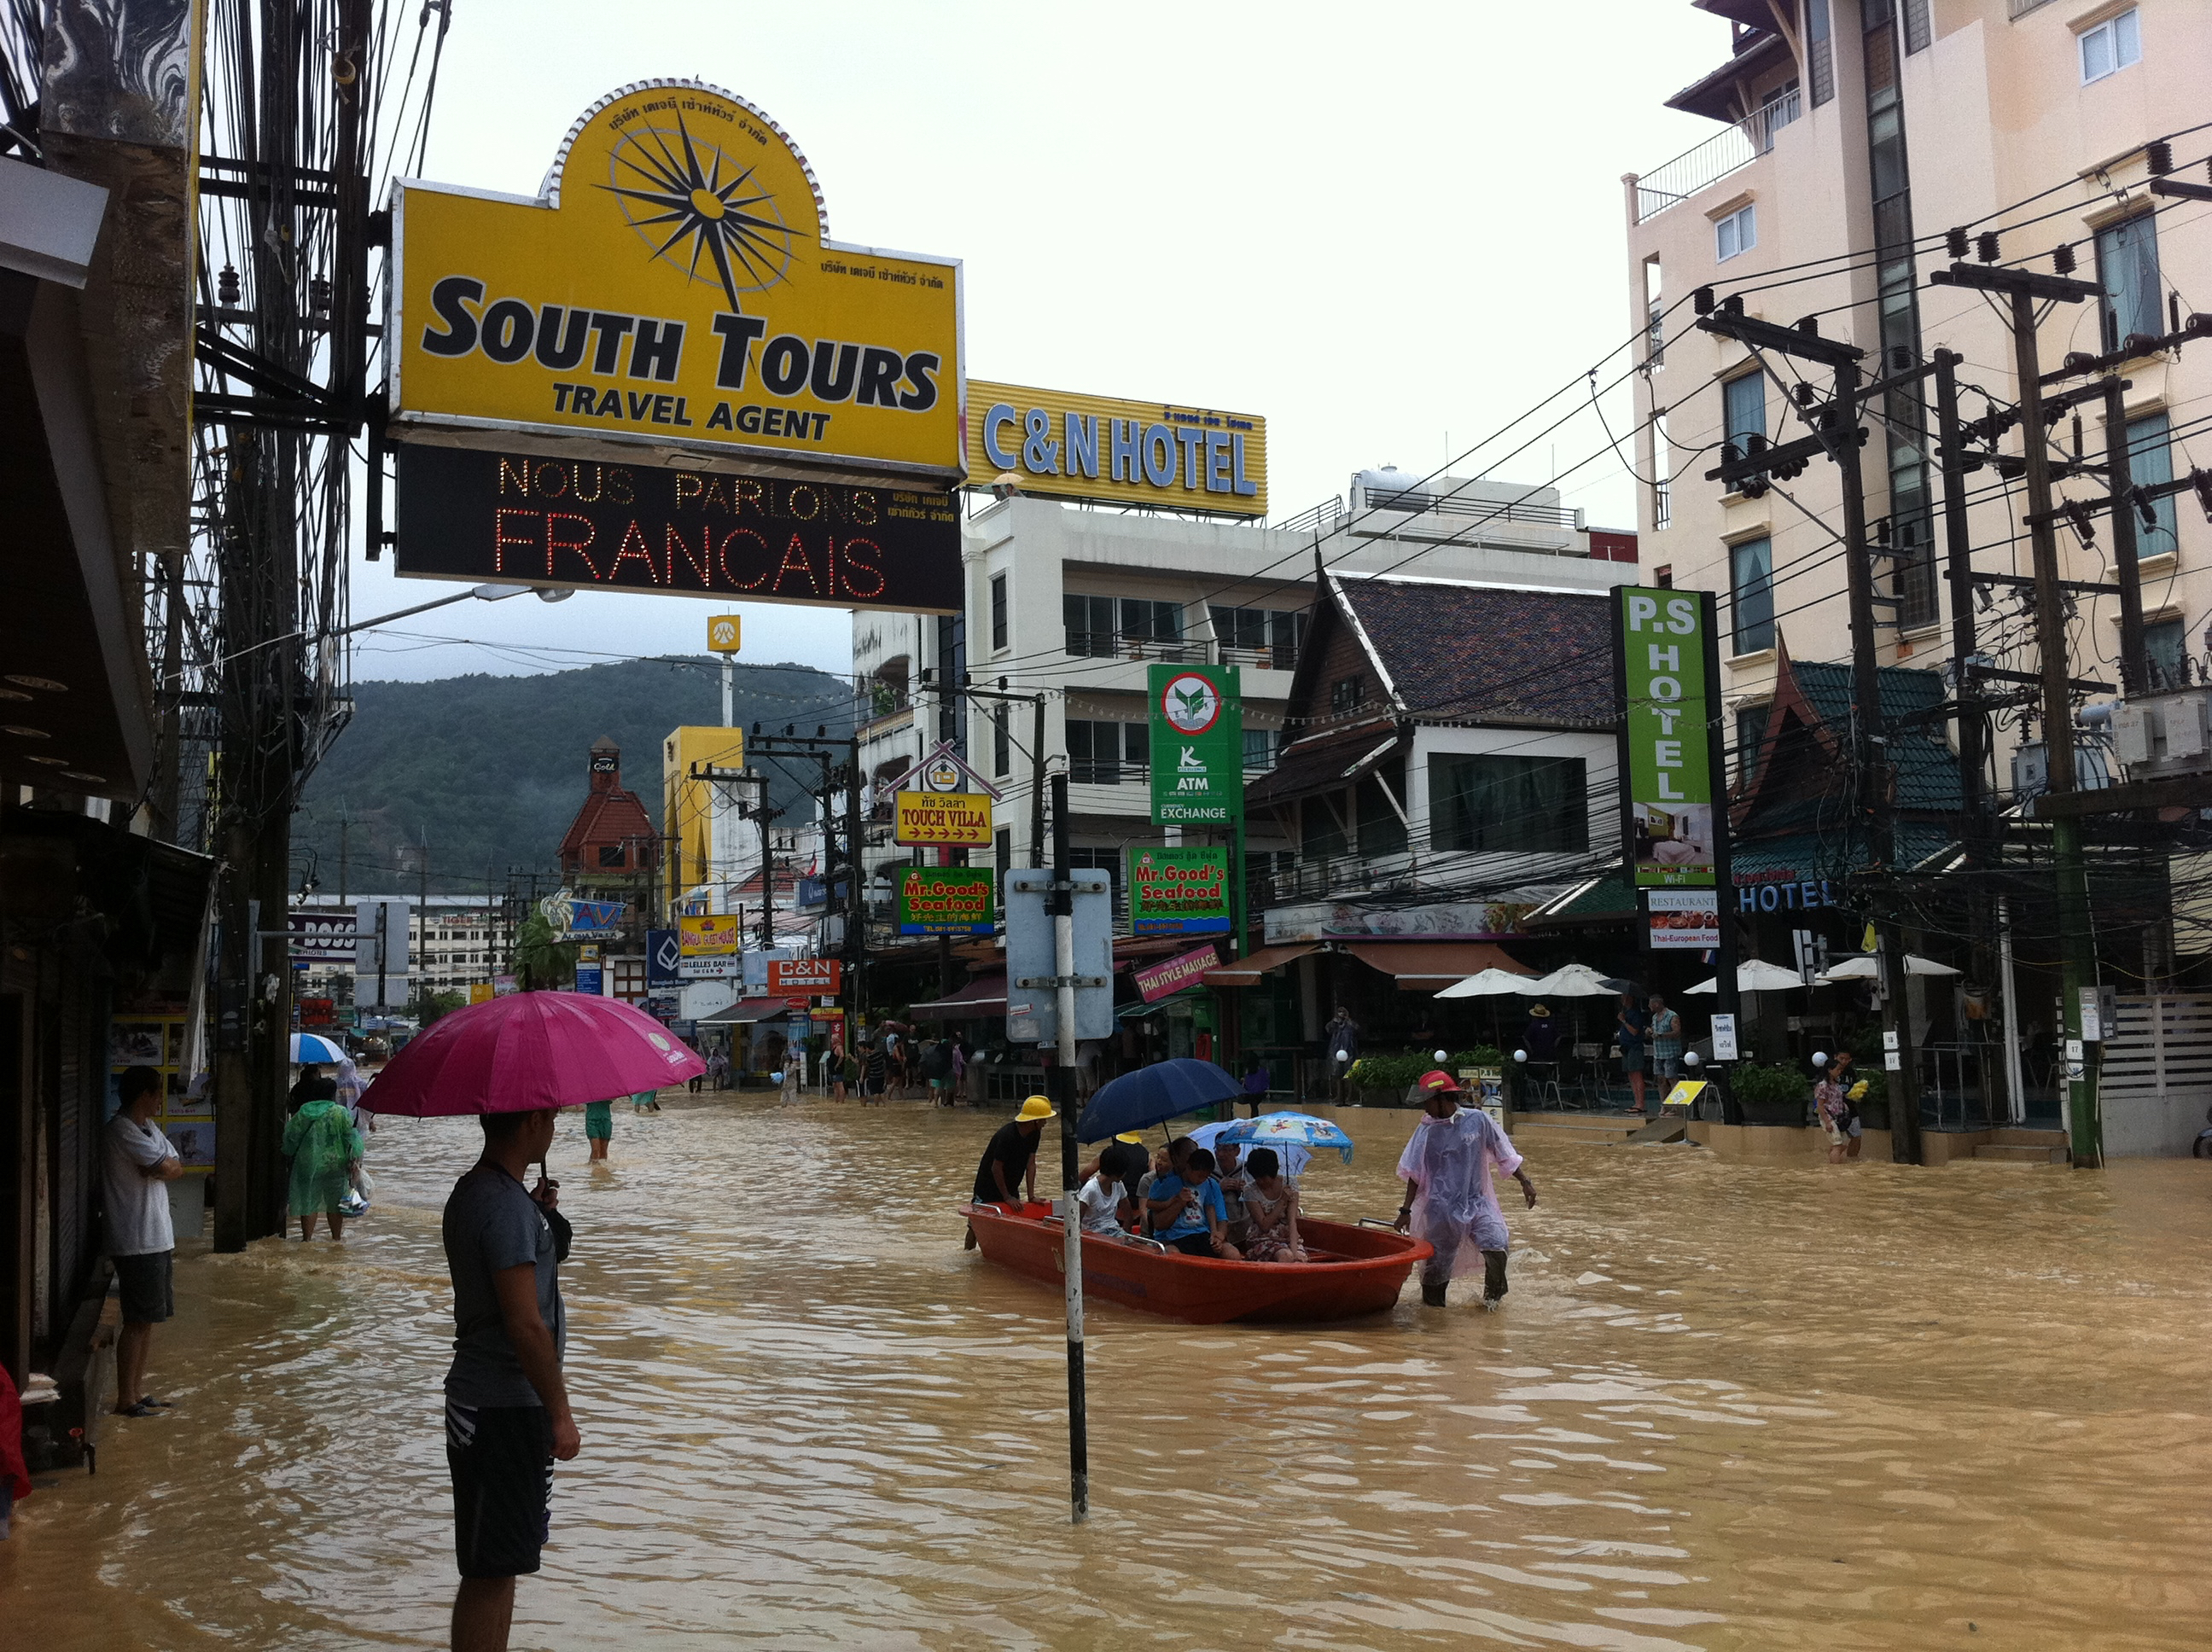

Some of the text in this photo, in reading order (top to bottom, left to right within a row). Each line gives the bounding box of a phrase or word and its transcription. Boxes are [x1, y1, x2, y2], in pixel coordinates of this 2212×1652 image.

[421, 274, 941, 414] SOUTH TOURS
[552, 382, 831, 441] TRAVEL AGENT
[984, 403, 1258, 497] C&N HOTEL
[498, 457, 879, 526] NOUS PARLONS
[494, 507, 887, 598] FRANCAIS
[1628, 596, 1696, 635] P.S
[1648, 643, 1685, 800] HOTEL
[1179, 746, 1203, 766] K
[1177, 777, 1208, 790] ATM
[902, 809, 987, 827] TOUCH VILLA
[1161, 808, 1225, 818] EXCHANGE
[1136, 864, 1225, 882] Mr.Good's
[904, 881, 988, 896] Mr.Good's
[1141, 882, 1220, 899] Seafood
[1739, 881, 1837, 912] HOTEL
[909, 896, 985, 911] Seafood
[1650, 898, 1715, 906] RESTAURANT
[304, 922, 356, 948] BOSS
[1653, 934, 1719, 943] Thai-European Food
[779, 961, 830, 975] C&N
[1138, 953, 1218, 992] THAI STYLE MASSAGE
